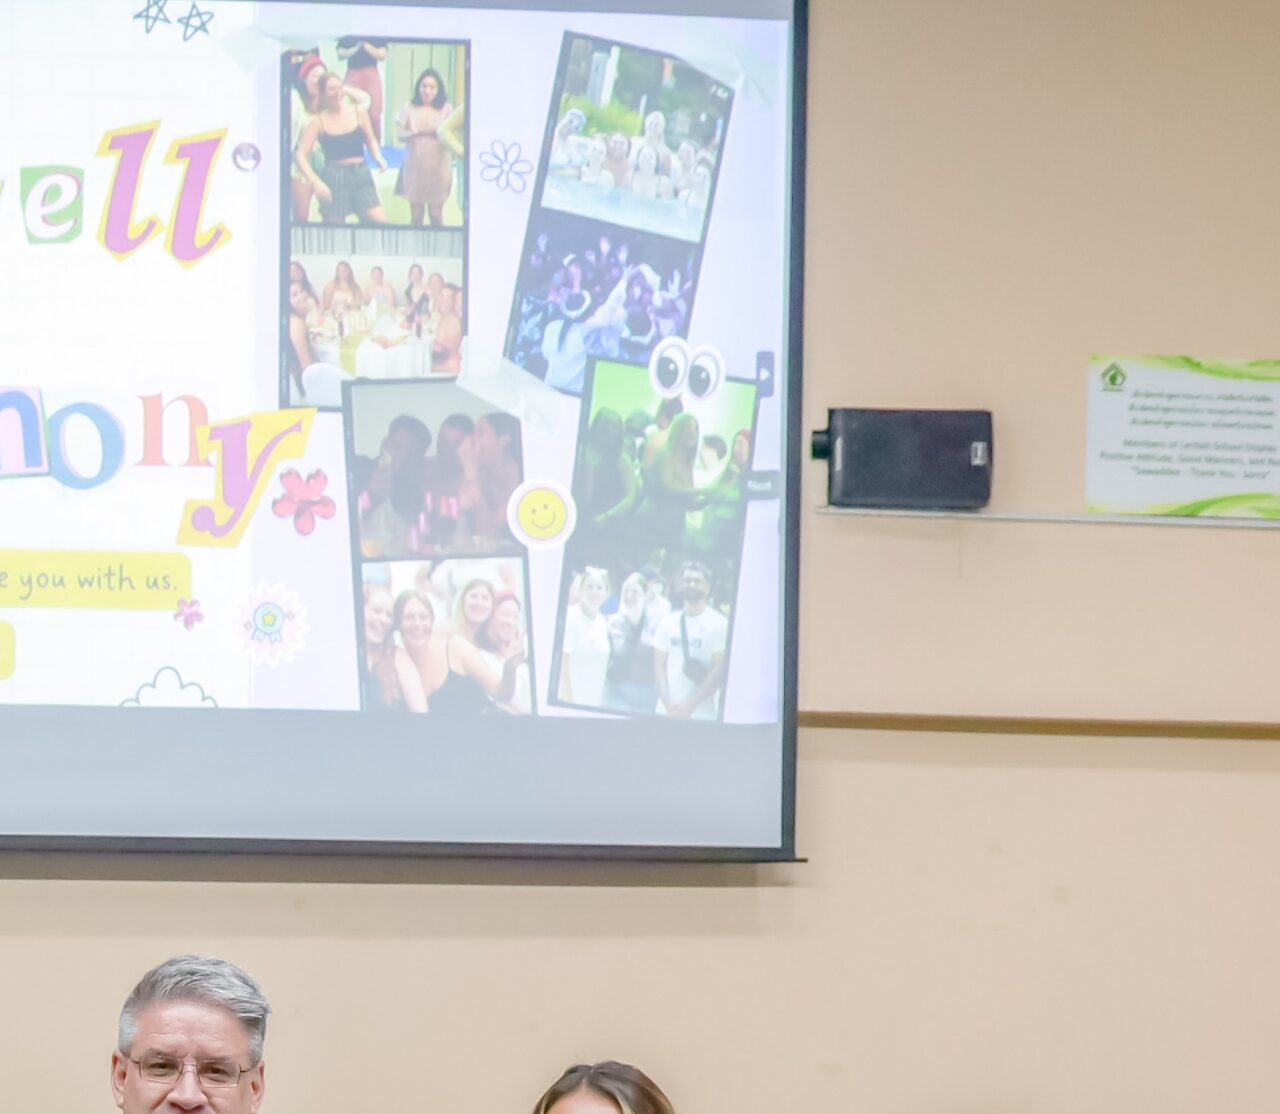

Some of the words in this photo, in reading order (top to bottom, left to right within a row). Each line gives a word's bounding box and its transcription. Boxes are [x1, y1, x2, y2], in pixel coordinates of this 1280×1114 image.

[19, 570, 66, 600] you
[77, 566, 135, 591] with
[146, 573, 179, 592] us.
